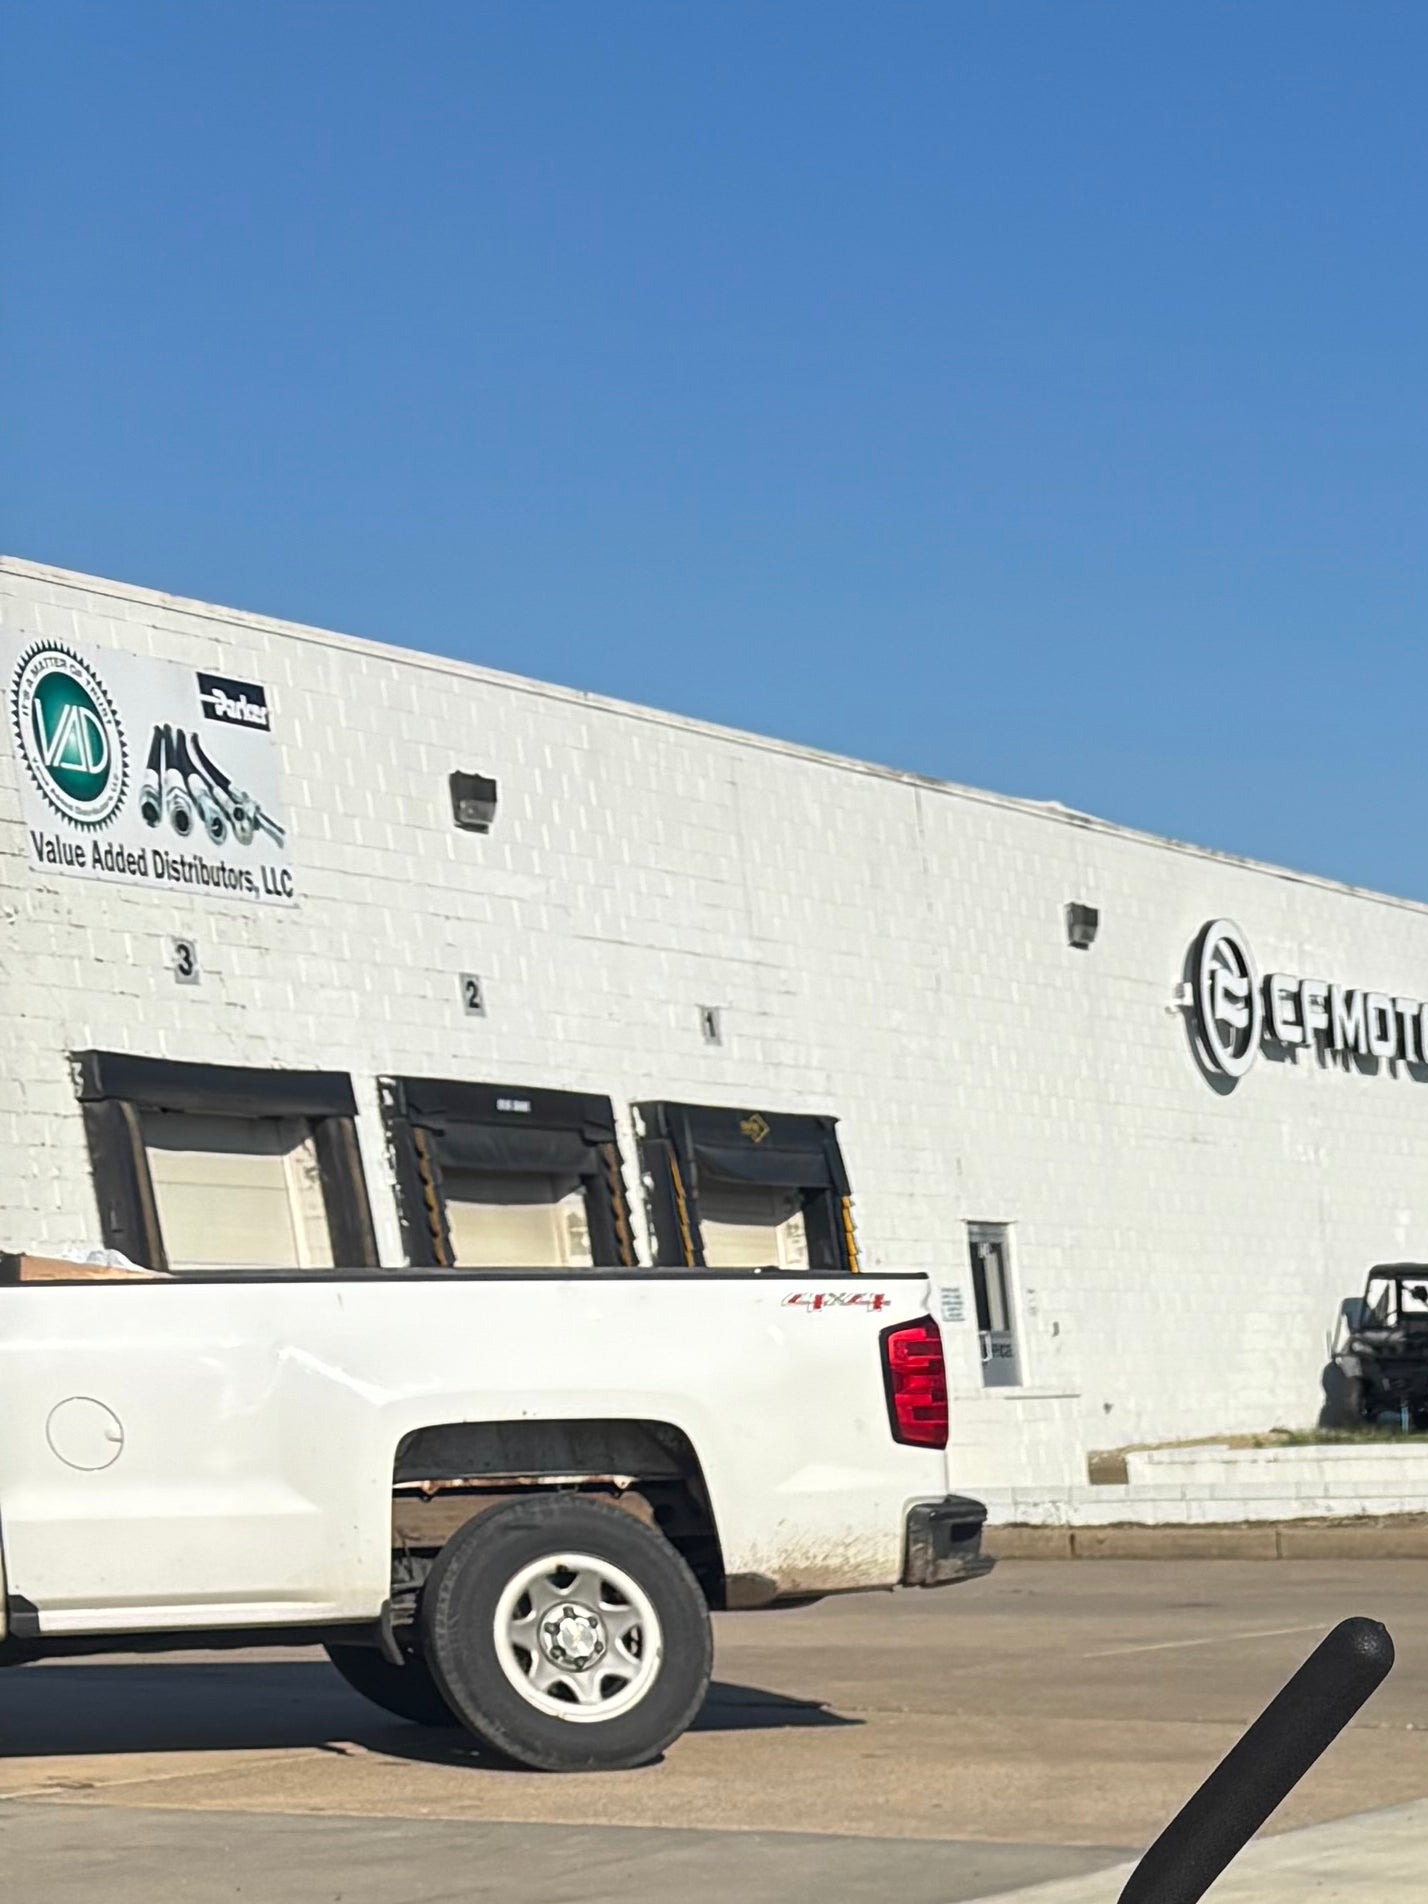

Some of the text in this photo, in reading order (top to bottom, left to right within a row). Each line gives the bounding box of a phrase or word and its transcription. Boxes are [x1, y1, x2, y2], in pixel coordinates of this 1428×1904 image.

[200, 688, 267, 725] Parker
[30, 830, 294, 899] Value Added Distributors, LLC
[176, 943, 193, 976] 3
[466, 980, 480, 1009] 2
